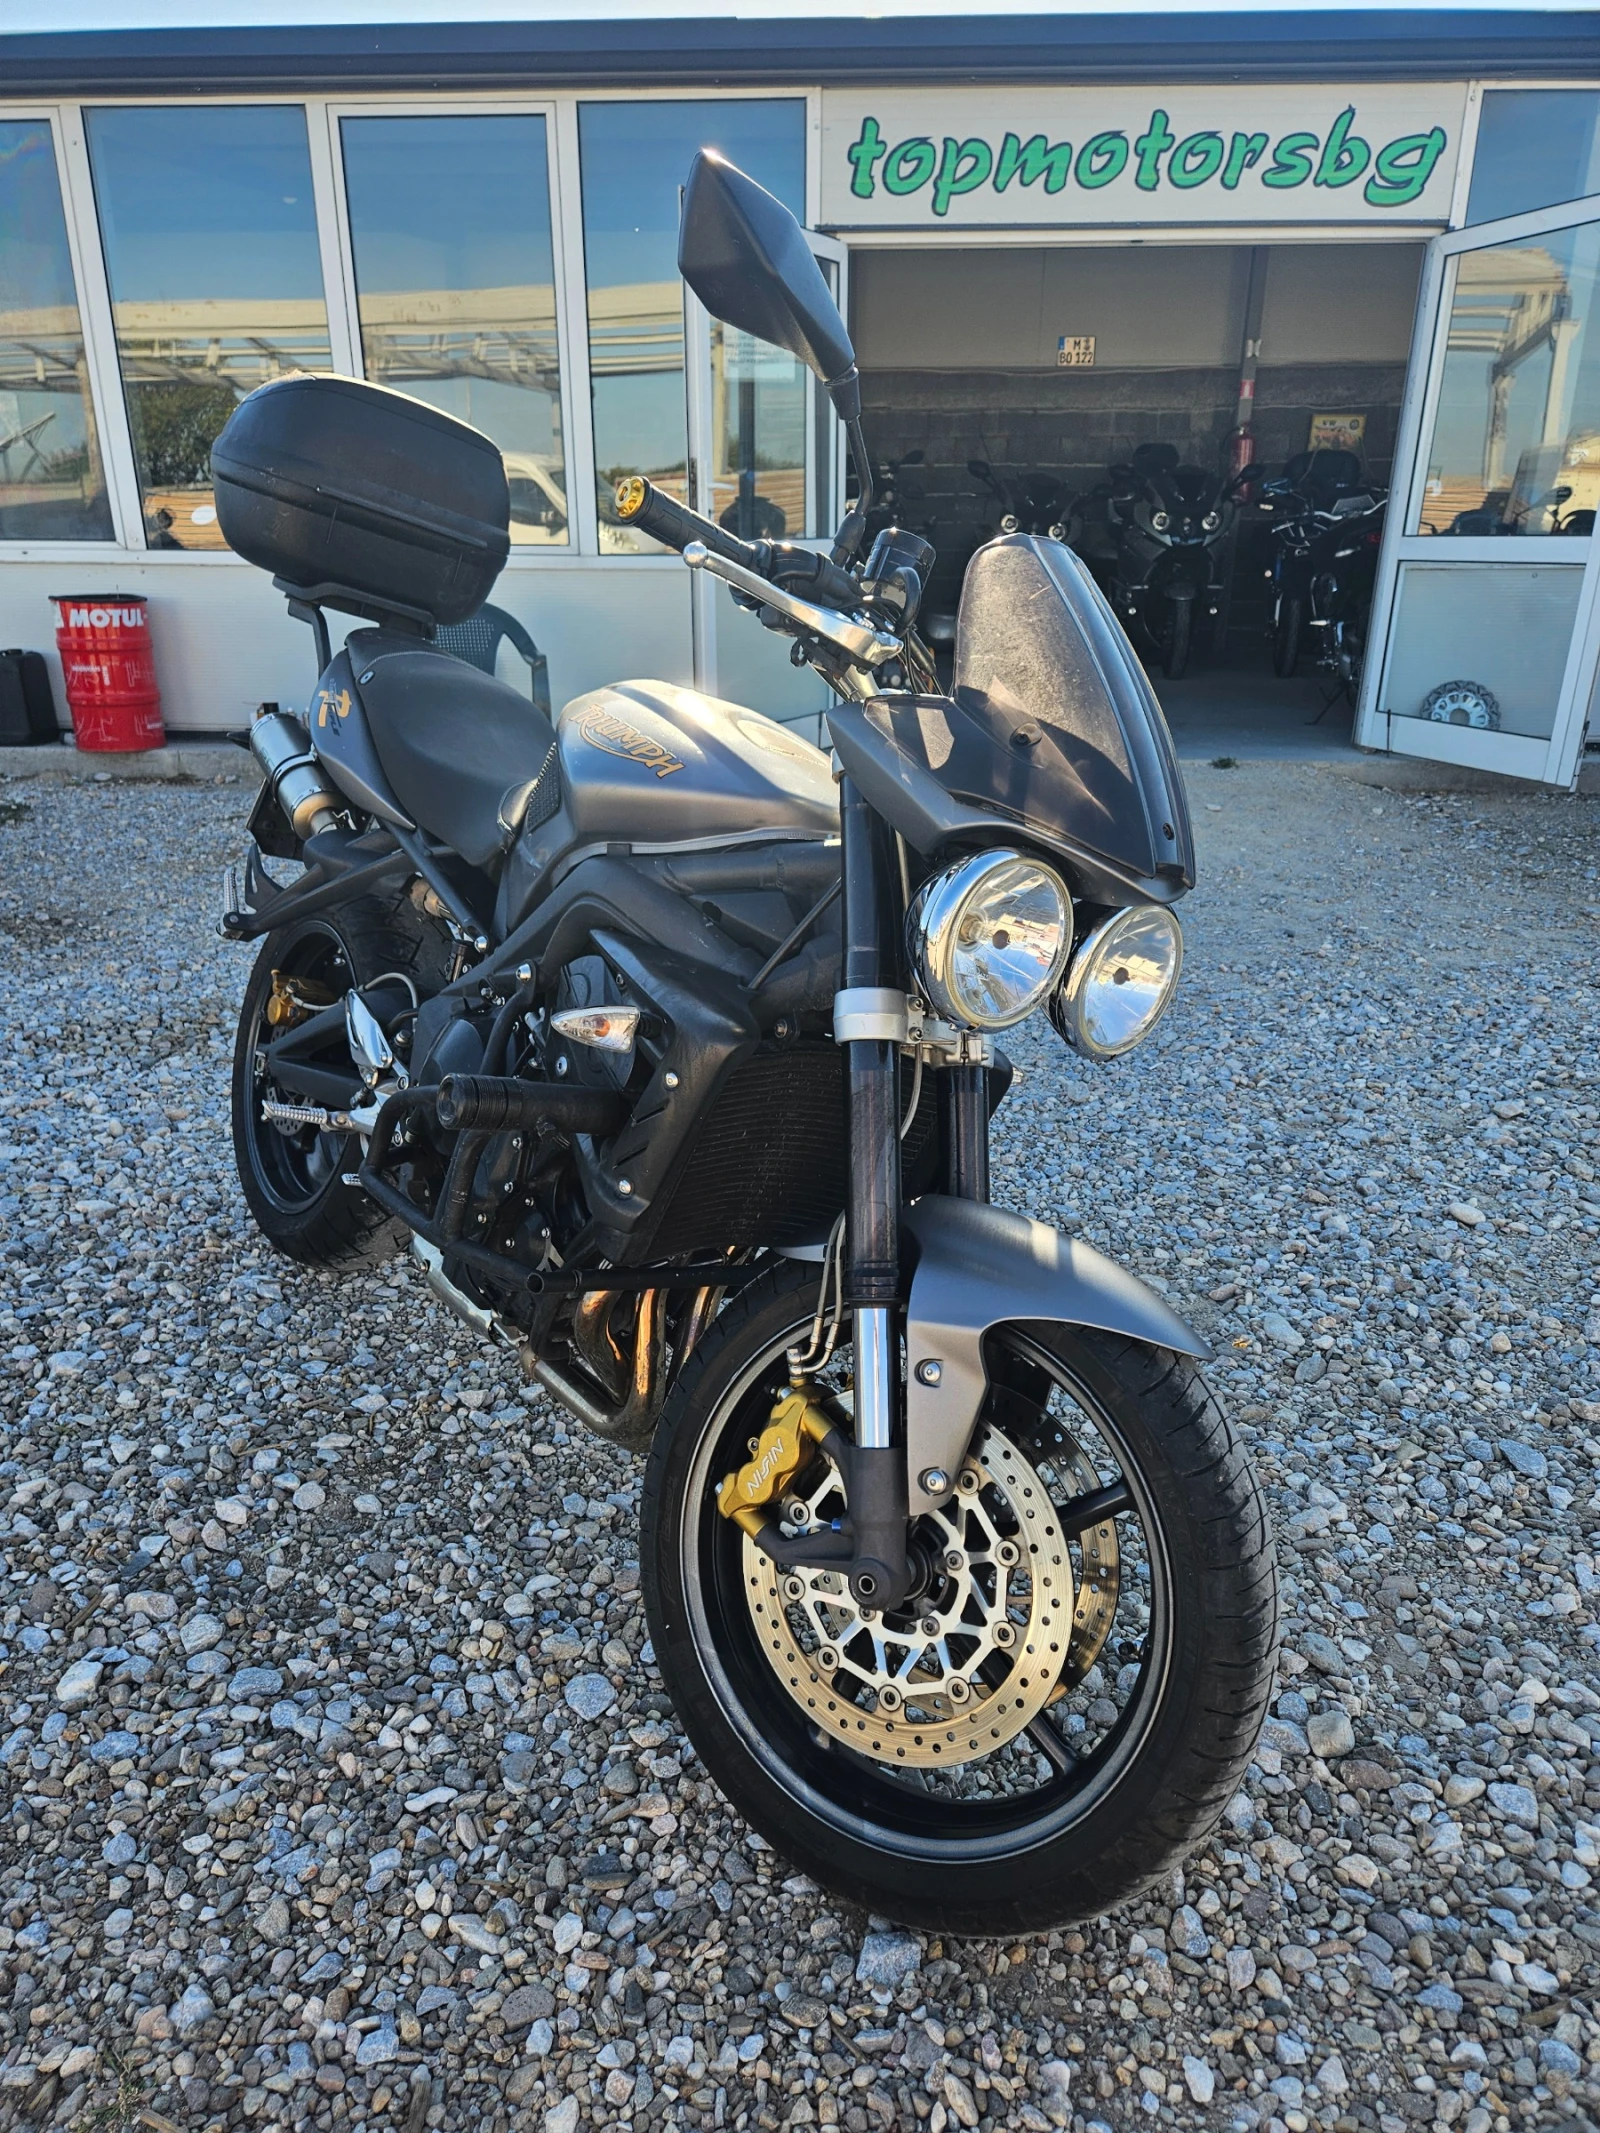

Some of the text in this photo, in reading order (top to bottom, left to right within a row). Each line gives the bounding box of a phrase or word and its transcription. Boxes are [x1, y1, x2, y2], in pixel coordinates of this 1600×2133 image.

[849, 104, 1447, 216] topmotorsbg
[69, 608, 144, 628] MOTUL
[569, 703, 686, 779] TRIUMPH
